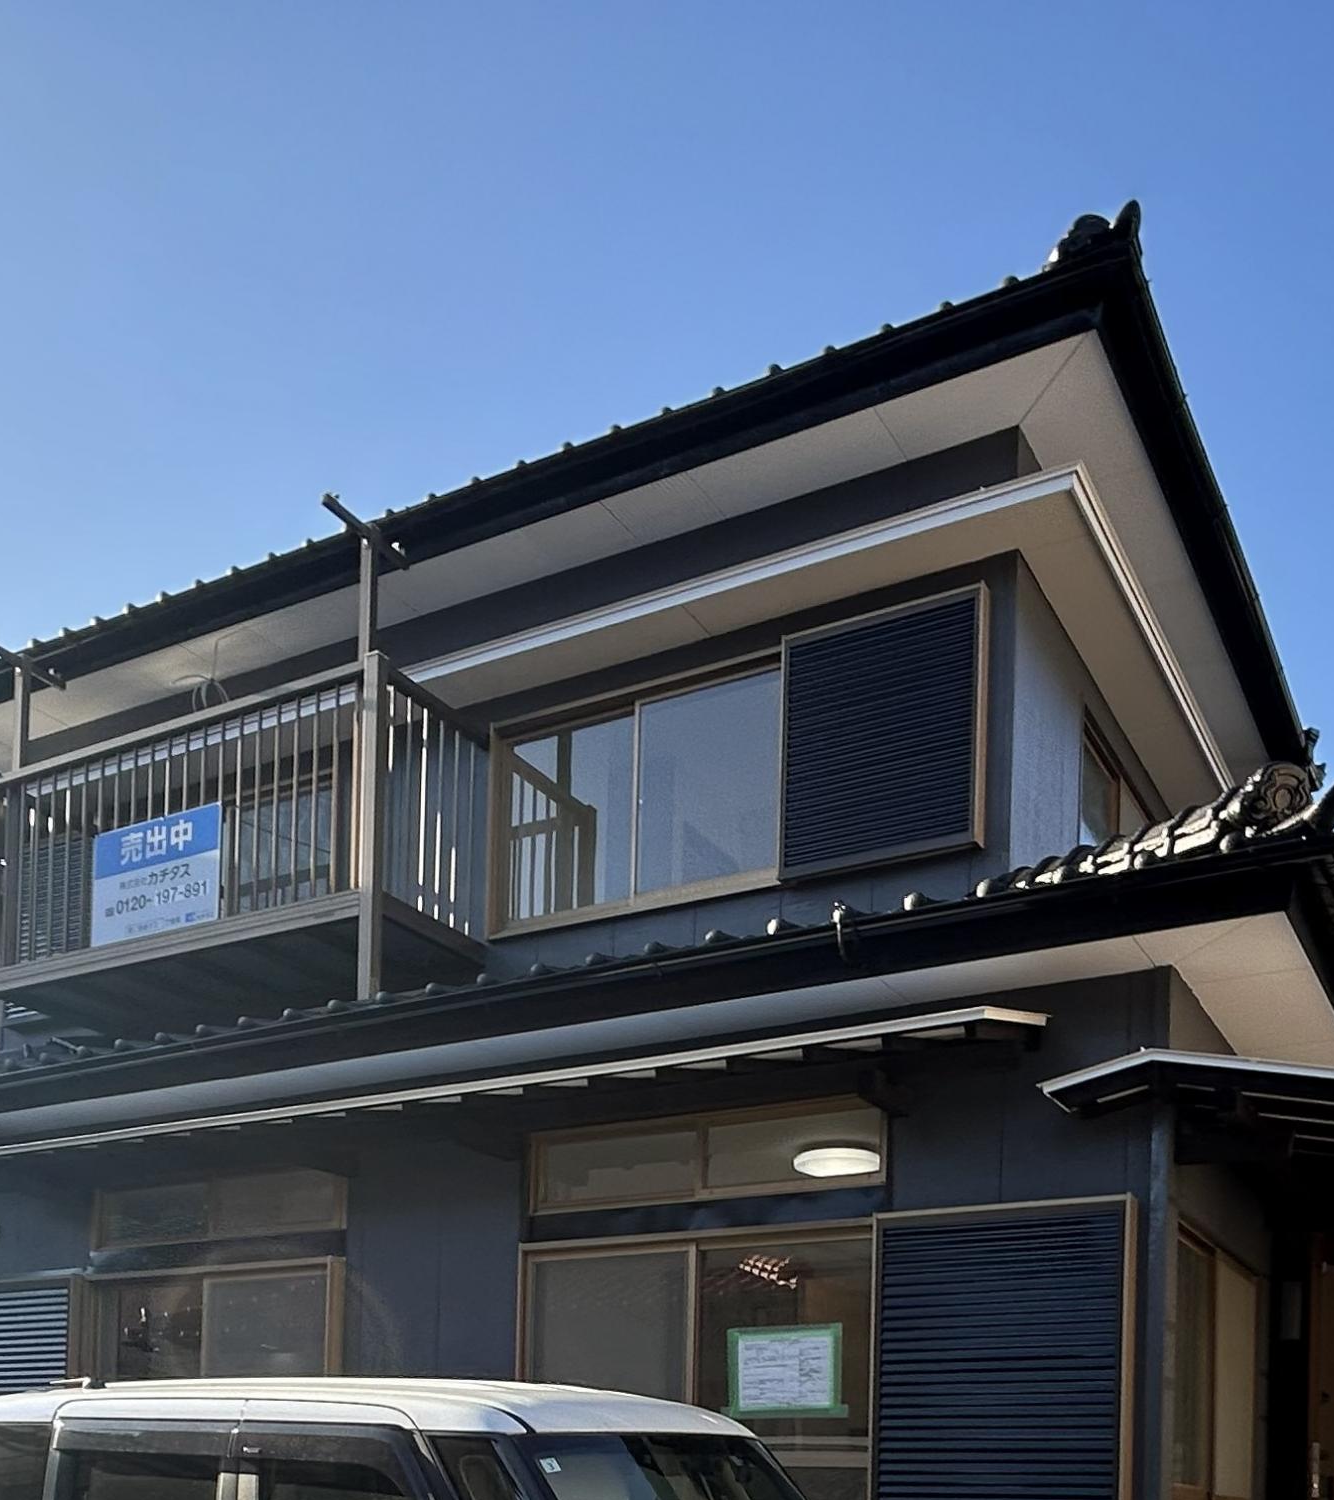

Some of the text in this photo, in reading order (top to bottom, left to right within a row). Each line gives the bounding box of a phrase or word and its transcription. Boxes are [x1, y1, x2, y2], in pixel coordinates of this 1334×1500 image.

[120, 819, 193, 866] 売出中
[116, 881, 207, 914] 0120-197-891
